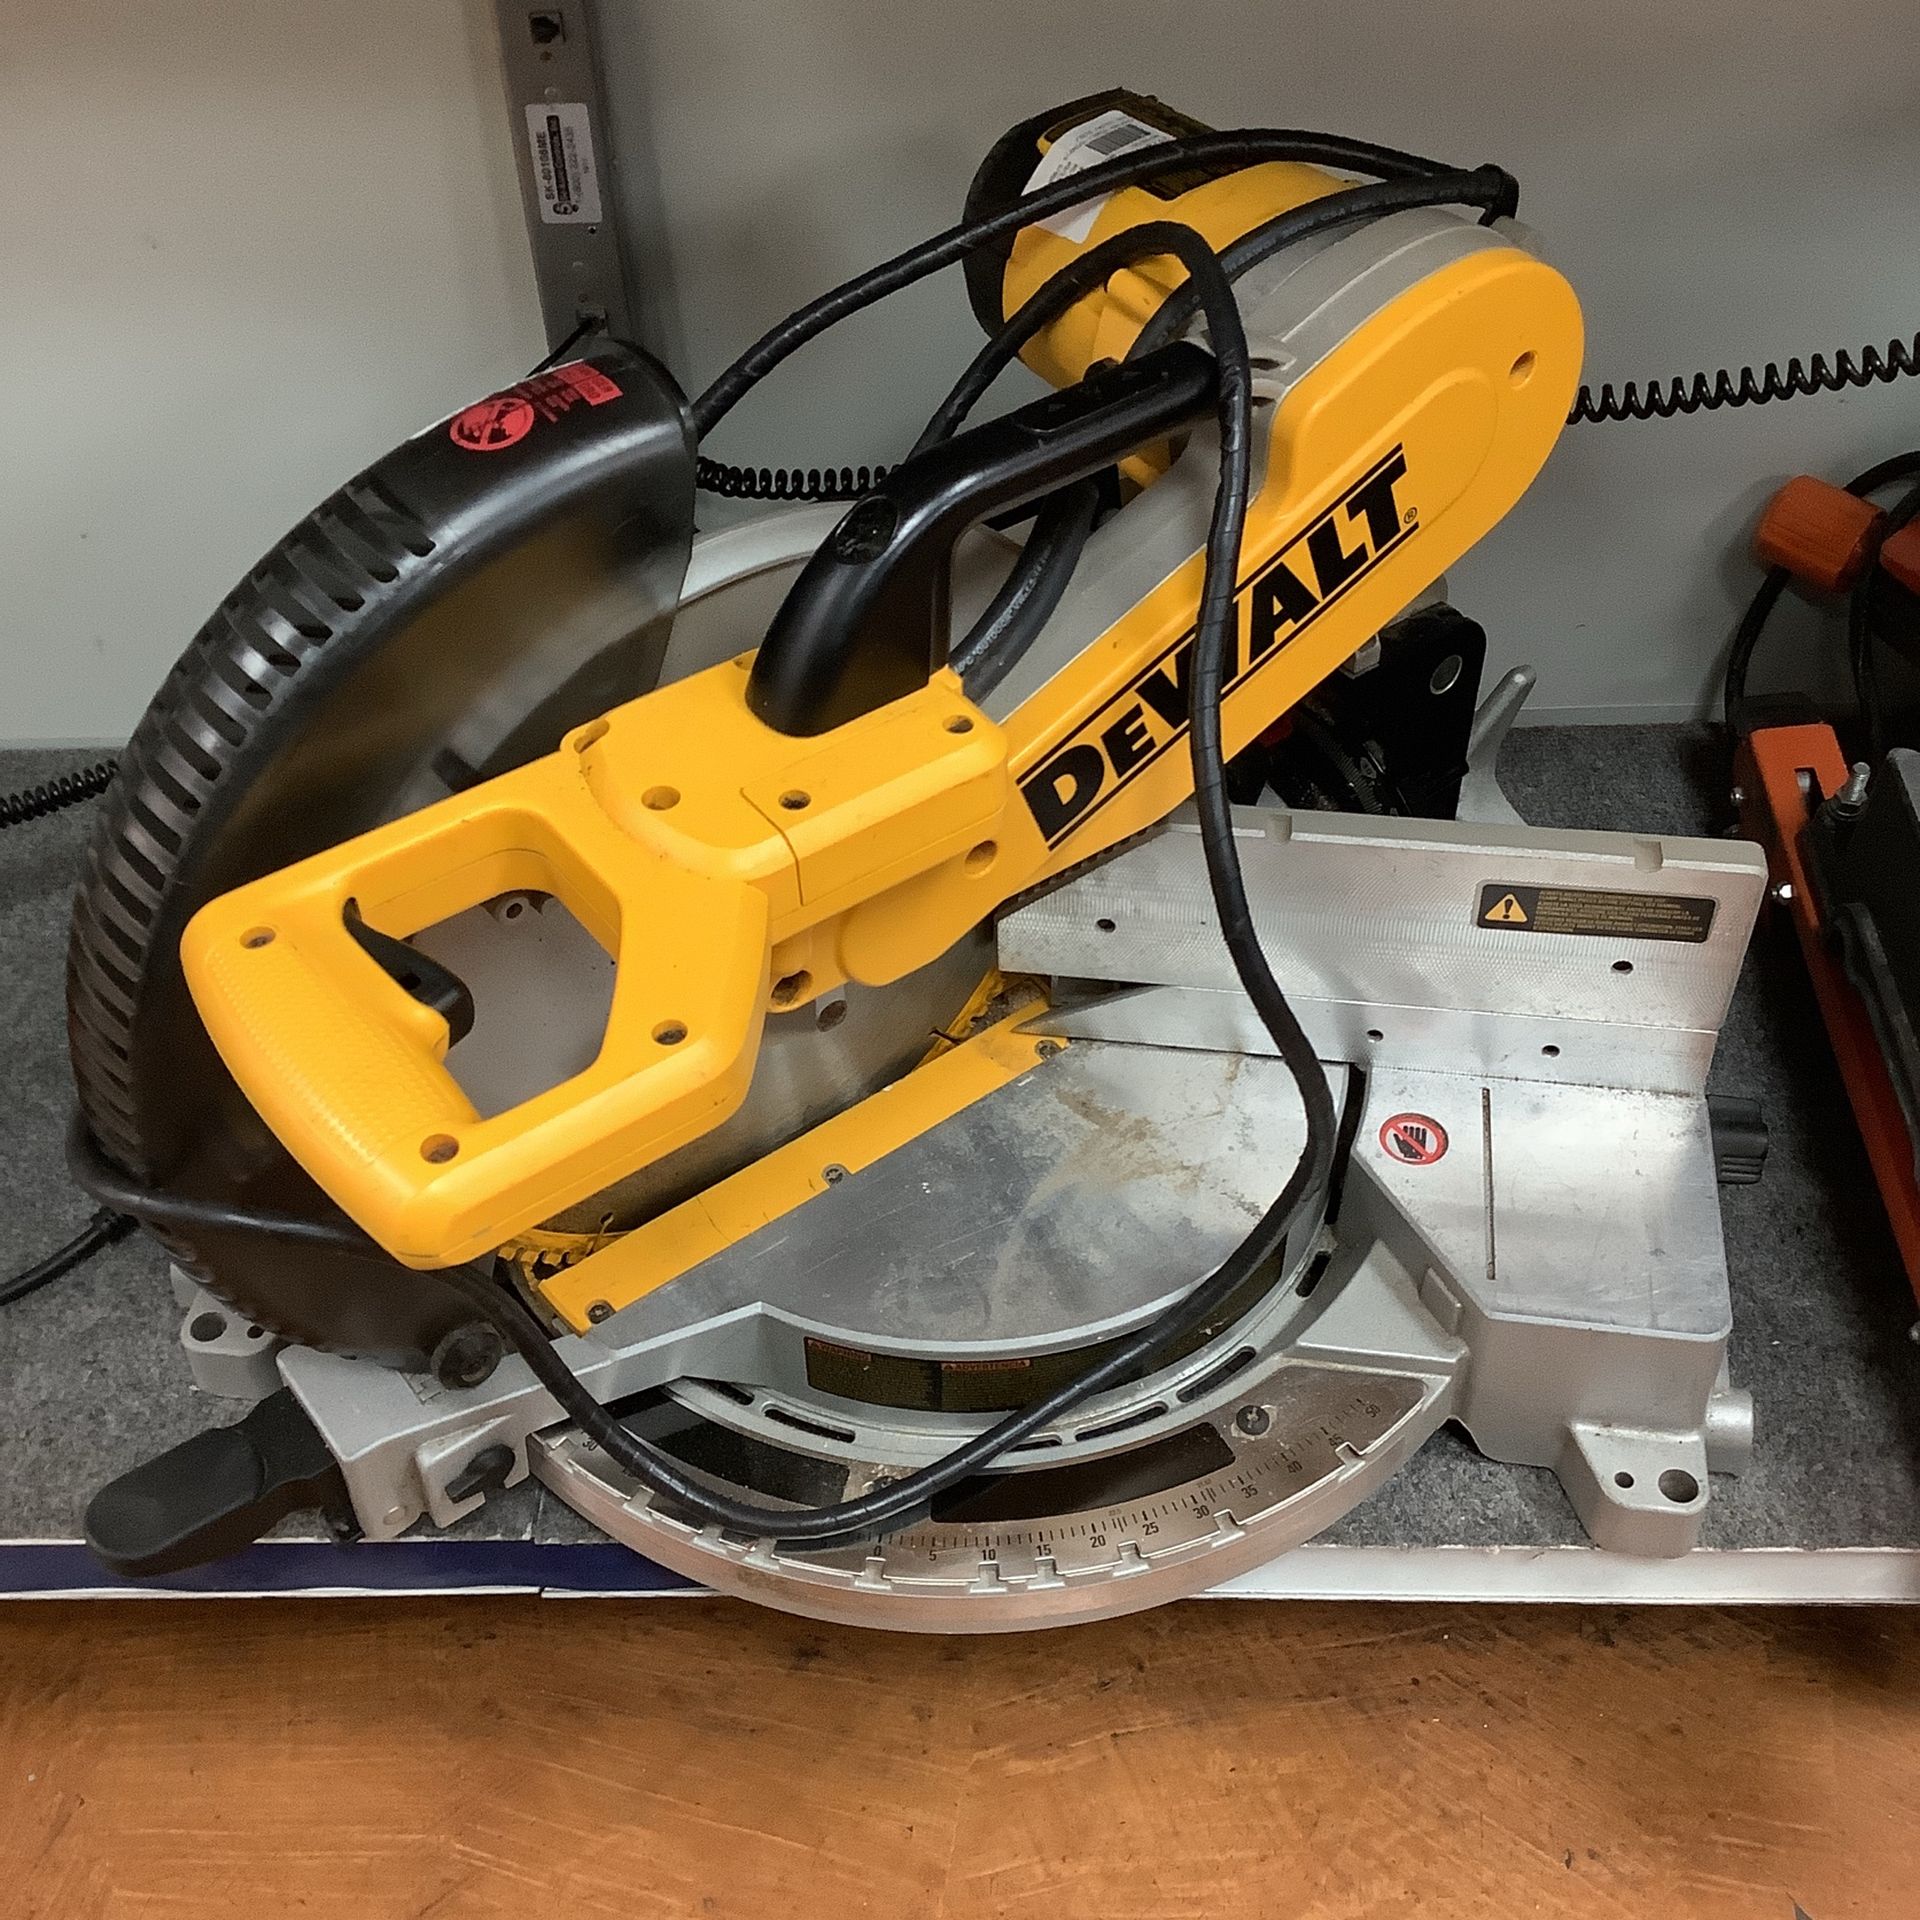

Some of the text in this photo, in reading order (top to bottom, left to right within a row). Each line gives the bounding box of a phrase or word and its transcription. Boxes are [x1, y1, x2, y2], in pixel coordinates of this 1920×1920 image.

[1020, 452, 1407, 842] DEWALT
[873, 1545, 882, 1556] 0
[928, 1551, 937, 1562] 5
[982, 1549, 997, 1561] 10
[1036, 1544, 1052, 1556] 15
[1090, 1535, 1107, 1548] 20
[1142, 1522, 1159, 1536] 25
[1193, 1505, 1210, 1519] 30
[1241, 1485, 1258, 1499] 35
[1287, 1460, 1303, 1473] 40
[1365, 1404, 1381, 1418] 50
